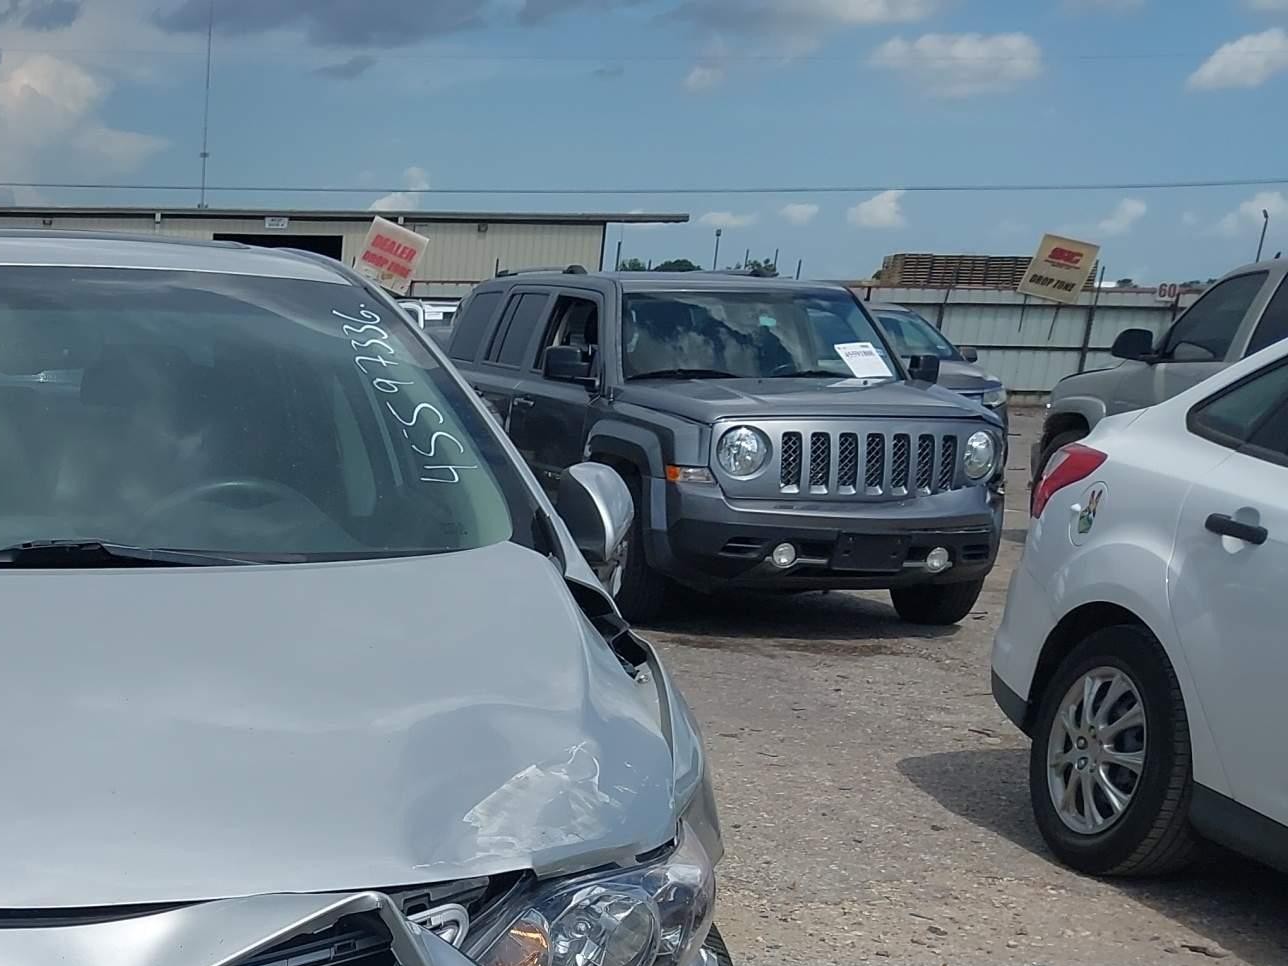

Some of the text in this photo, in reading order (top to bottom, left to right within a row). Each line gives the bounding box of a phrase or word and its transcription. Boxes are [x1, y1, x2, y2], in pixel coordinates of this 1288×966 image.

[1029, 273, 1076, 292] DROP ZONE
[1159, 283, 1177, 298] 60
